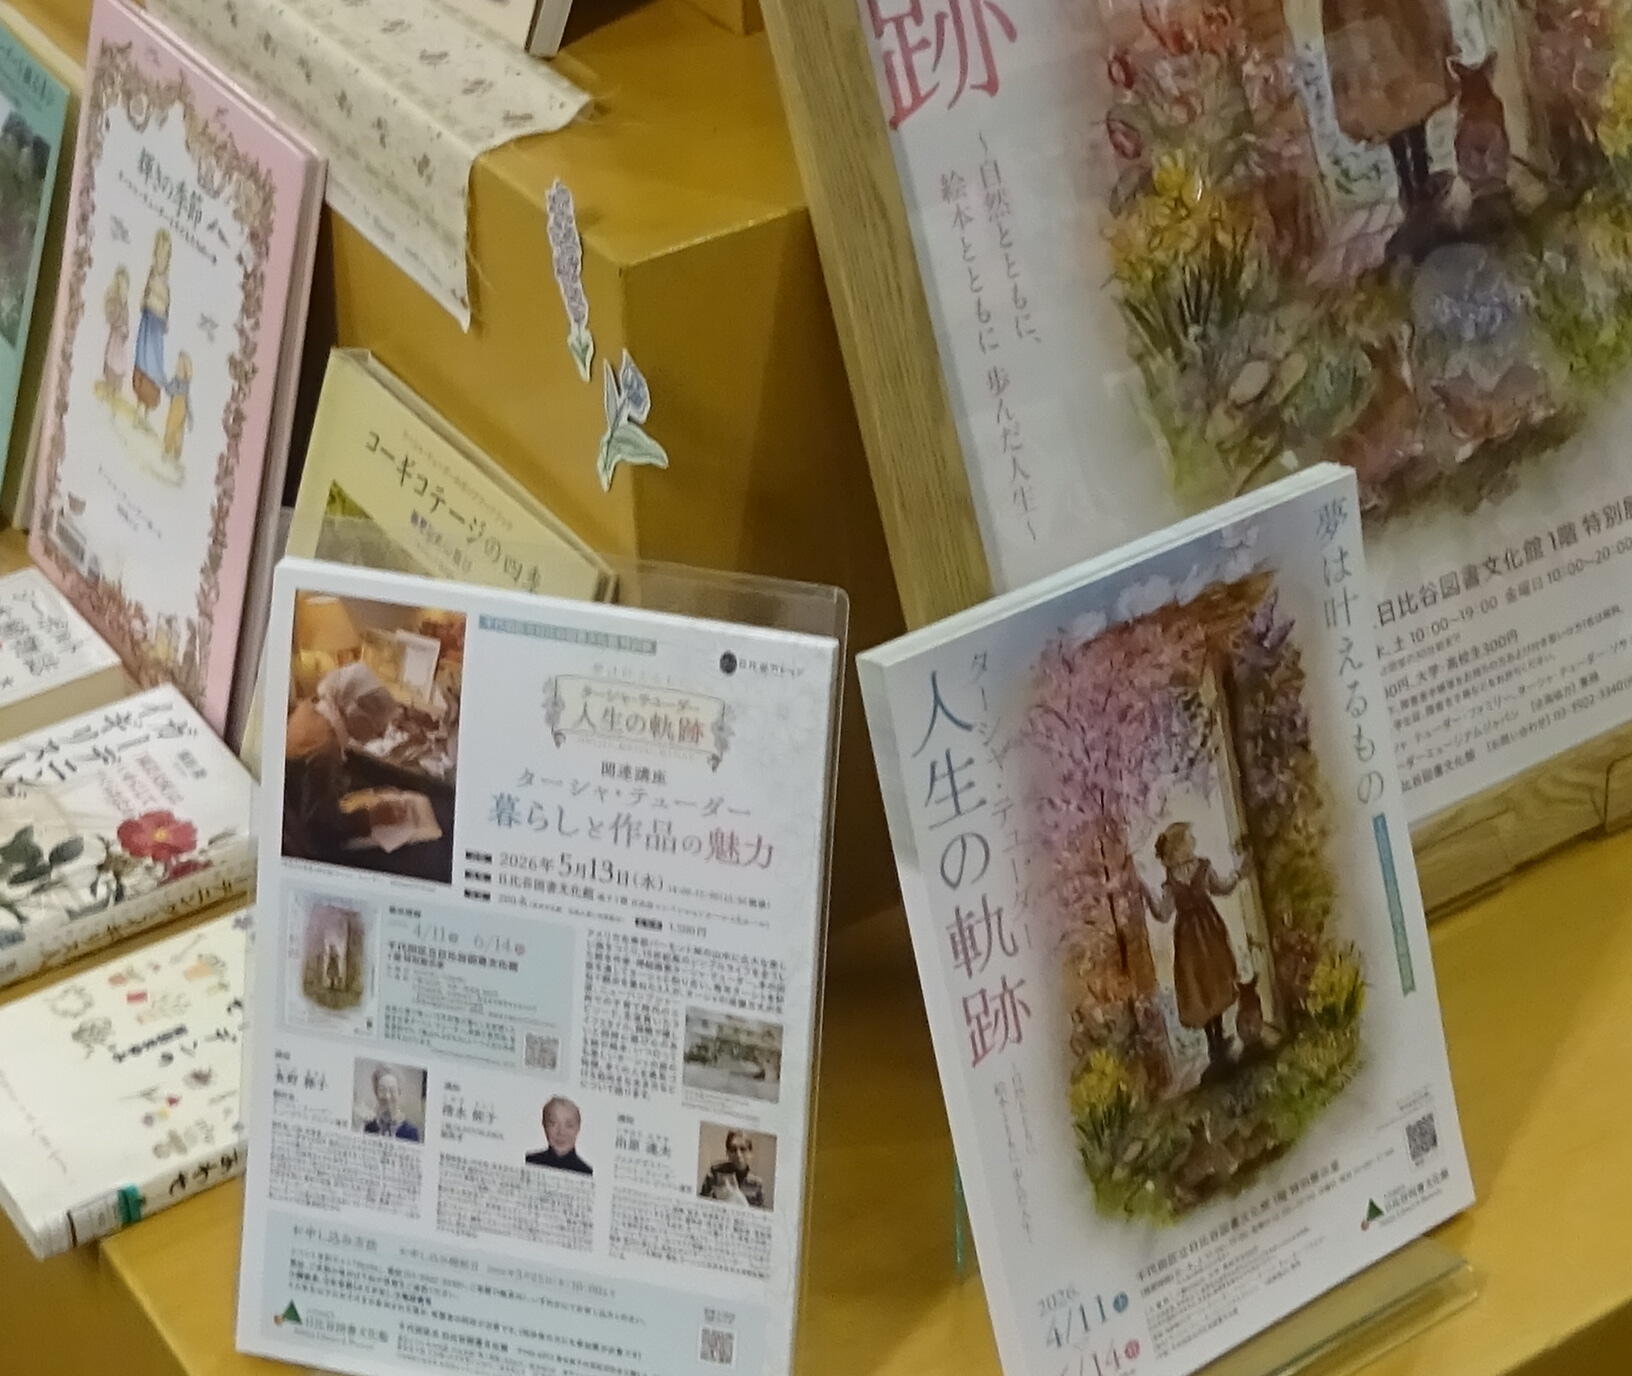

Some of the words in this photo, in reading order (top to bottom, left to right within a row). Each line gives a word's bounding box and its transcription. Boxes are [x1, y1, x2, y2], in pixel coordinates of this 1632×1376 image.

[939, 172, 999, 353] 絵本とともに
[365, 430, 544, 596] コーギコテージの四季
[1317, 500, 1387, 808] 夢は叶えるもの
[572, 699, 706, 749] 人生の軌跡
[600, 759, 667, 786] 関連講座
[487, 790, 776, 873] 暮らしと作品の魅力
[515, 767, 752, 826] ターシャ・テューダー
[970, 651, 1036, 954] ターシャ・テューダー
[497, 871, 595, 901] 日比谷図書文化館
[911, 667, 1032, 1071] 人生の軌跡
